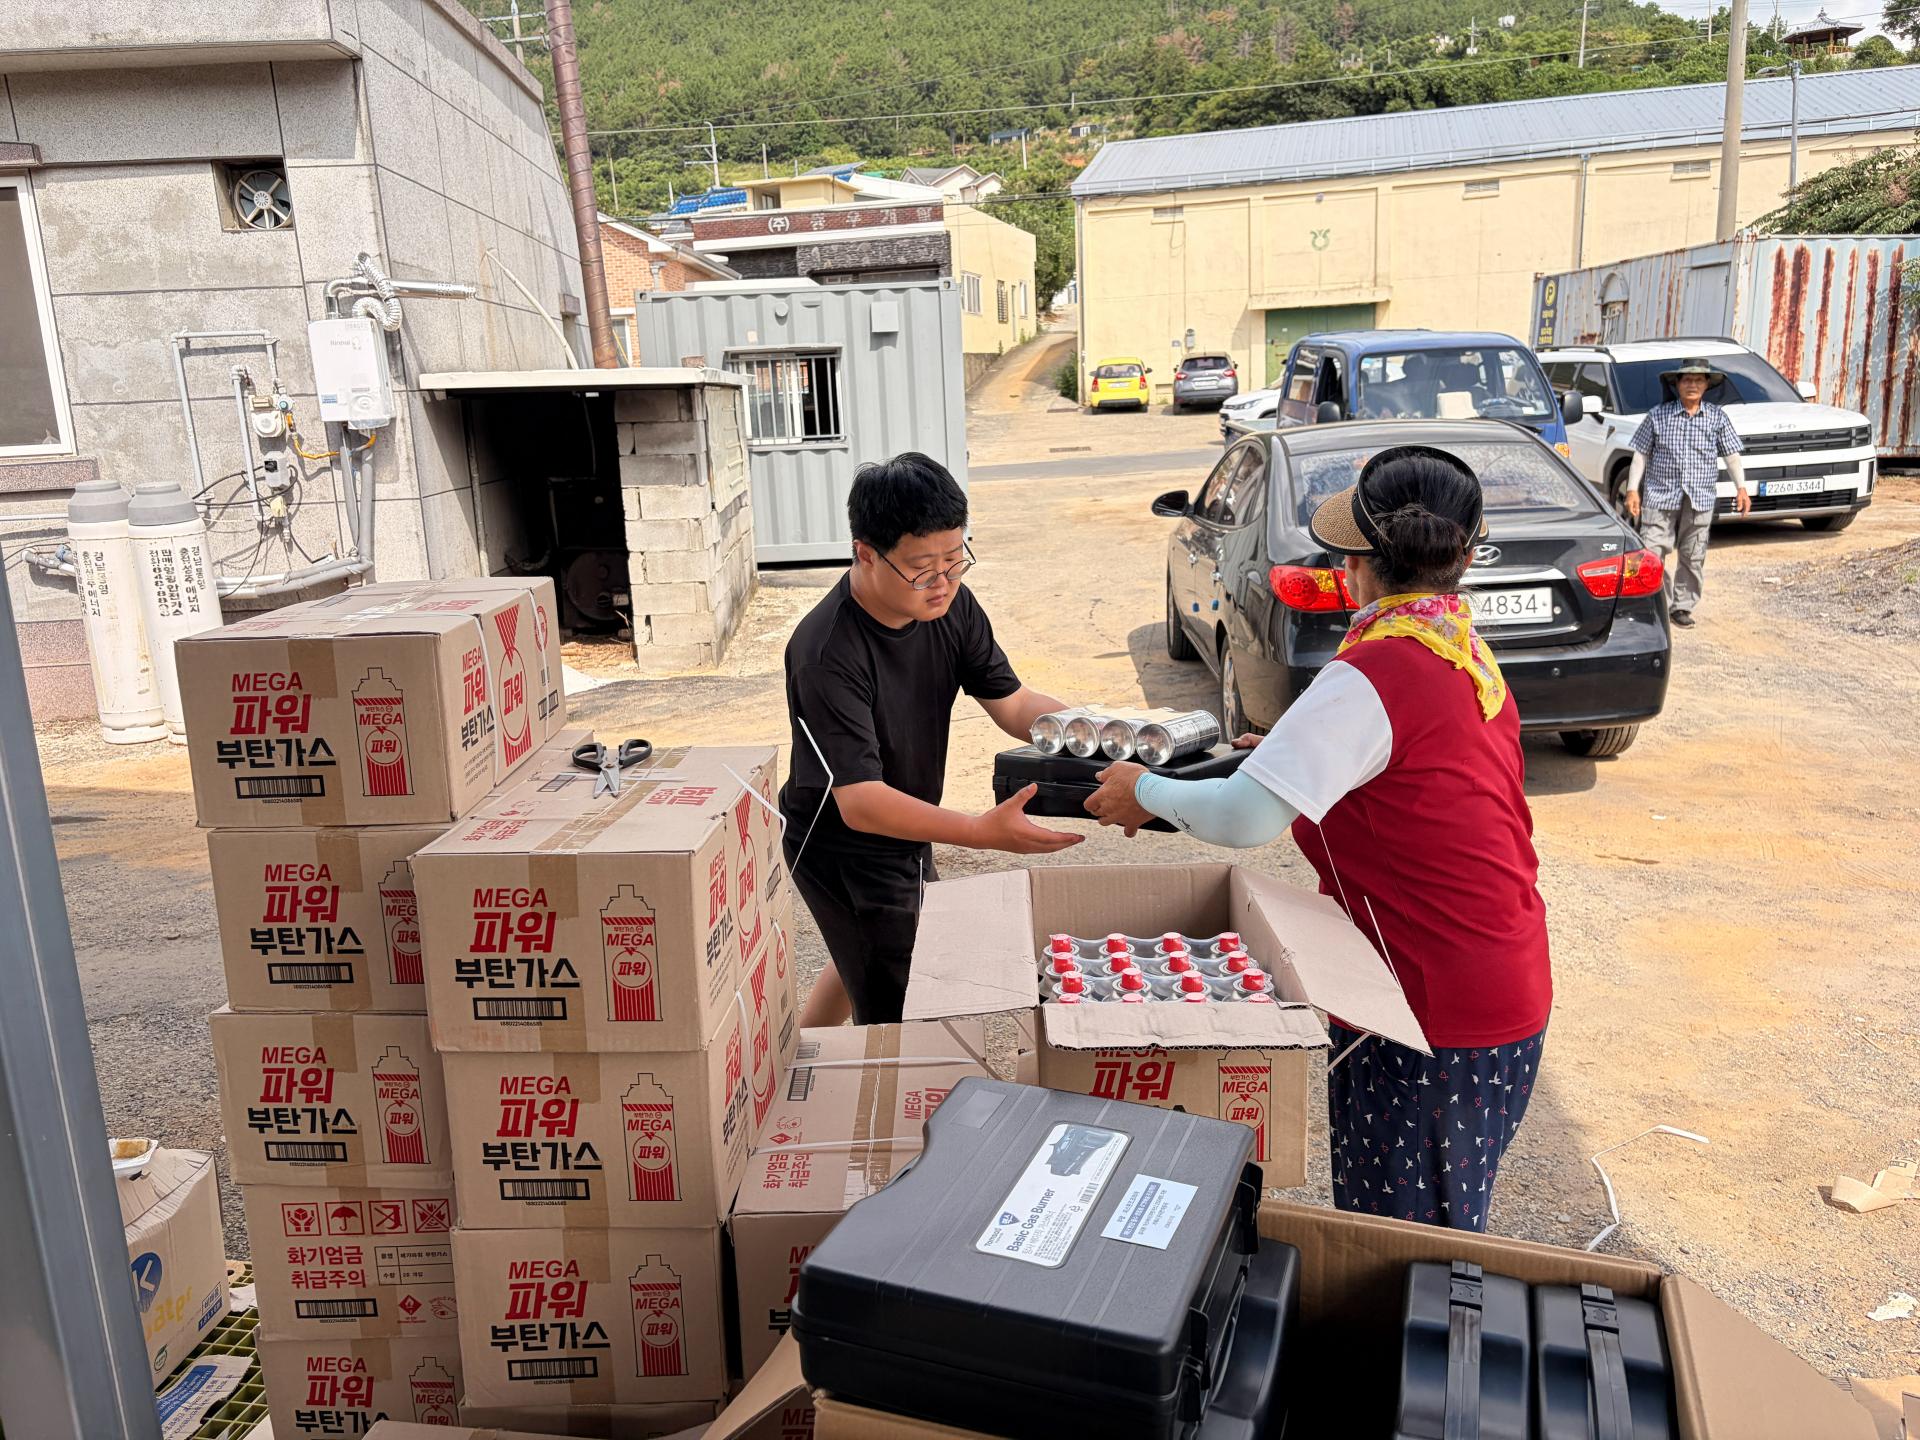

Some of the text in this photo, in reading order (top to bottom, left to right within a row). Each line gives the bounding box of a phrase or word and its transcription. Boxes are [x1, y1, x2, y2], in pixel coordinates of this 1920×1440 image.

[767, 216, 790, 233] (주)
[1796, 481, 1821, 492] 3344
[1481, 593, 1538, 616] 4834
[462, 646, 482, 673] MEGA
[231, 672, 302, 692] MEGA
[463, 664, 486, 716] 파워
[503, 670, 523, 717] 파워
[230, 694, 311, 735] 파워
[359, 712, 403, 726] MEGA
[461, 704, 495, 752] 부탄가스
[217, 737, 336, 769] 부탄가스
[370, 739, 397, 754] 파워
[264, 863, 332, 882] MEGA
[709, 845, 726, 881] MEGA
[708, 866, 727, 930] 파워
[738, 856, 754, 912] 파워
[262, 885, 340, 923] 파워
[473, 888, 549, 909] MEGA
[250, 927, 364, 956] 부탄가스
[469, 911, 556, 954] 파워
[606, 933, 654, 947] MEGA
[706, 906, 734, 967] 부탄가스
[455, 958, 580, 989] 부탄가스
[617, 961, 646, 976] 파워
[261, 1046, 327, 1065] MEGA
[754, 1016, 768, 1076] 파워
[259, 1067, 335, 1104] 파워
[499, 1076, 572, 1096] MEGA
[725, 1037, 742, 1109] 파워
[1089, 1061, 1176, 1100] 파워
[1222, 1081, 1268, 1093] MEGA
[378, 1087, 419, 1100] MEGA
[904, 1090, 922, 1120] MEGA
[247, 1107, 358, 1135] 부탄가스
[389, 1111, 414, 1125] 파워
[495, 1098, 579, 1138] 파워
[626, 1118, 673, 1132] MEGA
[722, 1076, 748, 1146] 부탄가스
[1231, 1106, 1260, 1121] 파워
[482, 1142, 603, 1171] 부탄가스
[638, 1145, 665, 1159] 파워
[763, 1153, 788, 1189] 화기엄금
[788, 1153, 813, 1189] 취급주의
[1006, 1230, 1030, 1252] Basic
[1021, 1214, 1040, 1230] Gas
[1031, 1188, 1056, 1214] Burner
[287, 1245, 363, 1266] 화기엄금
[508, 1259, 580, 1280] MEGA
[291, 1269, 366, 1290] 취급주의
[504, 1280, 588, 1320] 파워
[634, 1296, 680, 1310] MEGA
[490, 1321, 611, 1352] 부탄가스
[645, 1322, 673, 1336] 파워
[306, 1356, 367, 1373] MEGA
[305, 1375, 374, 1408] 파워
[415, 1394, 454, 1404] MEGA
[426, 1414, 449, 1426] 파워
